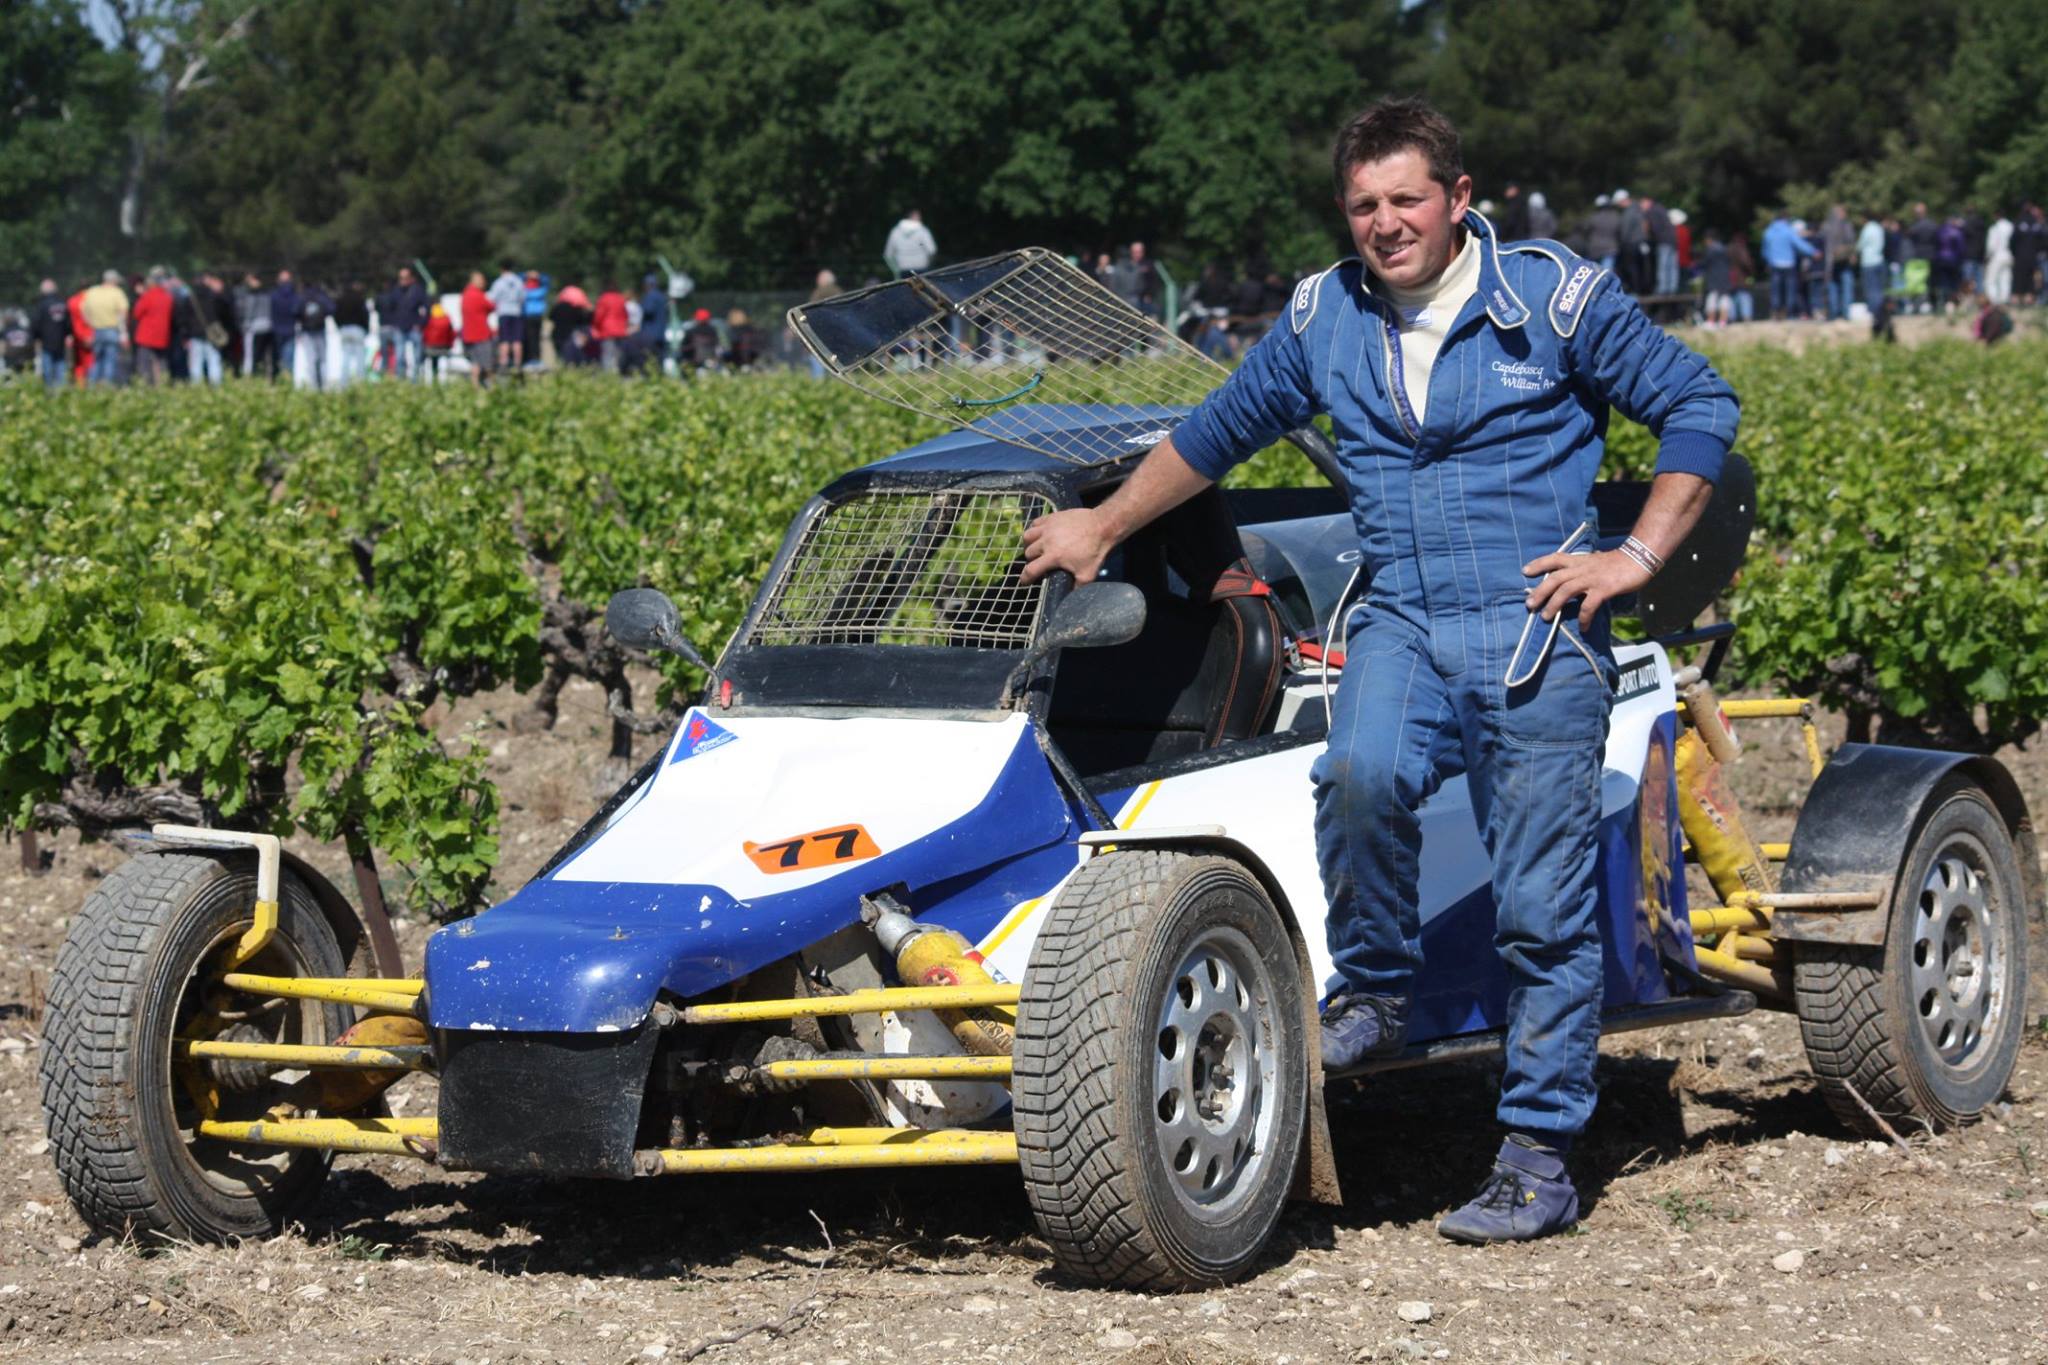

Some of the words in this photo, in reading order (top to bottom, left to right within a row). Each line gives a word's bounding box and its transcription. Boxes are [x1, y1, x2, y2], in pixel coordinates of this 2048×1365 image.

[1558, 265, 1590, 312] sparco
[1500, 376, 1541, 391] William
[1617, 669, 1639, 697] SPORT
[1638, 663, 1658, 688] AUTO
[758, 828, 860, 868] 77
